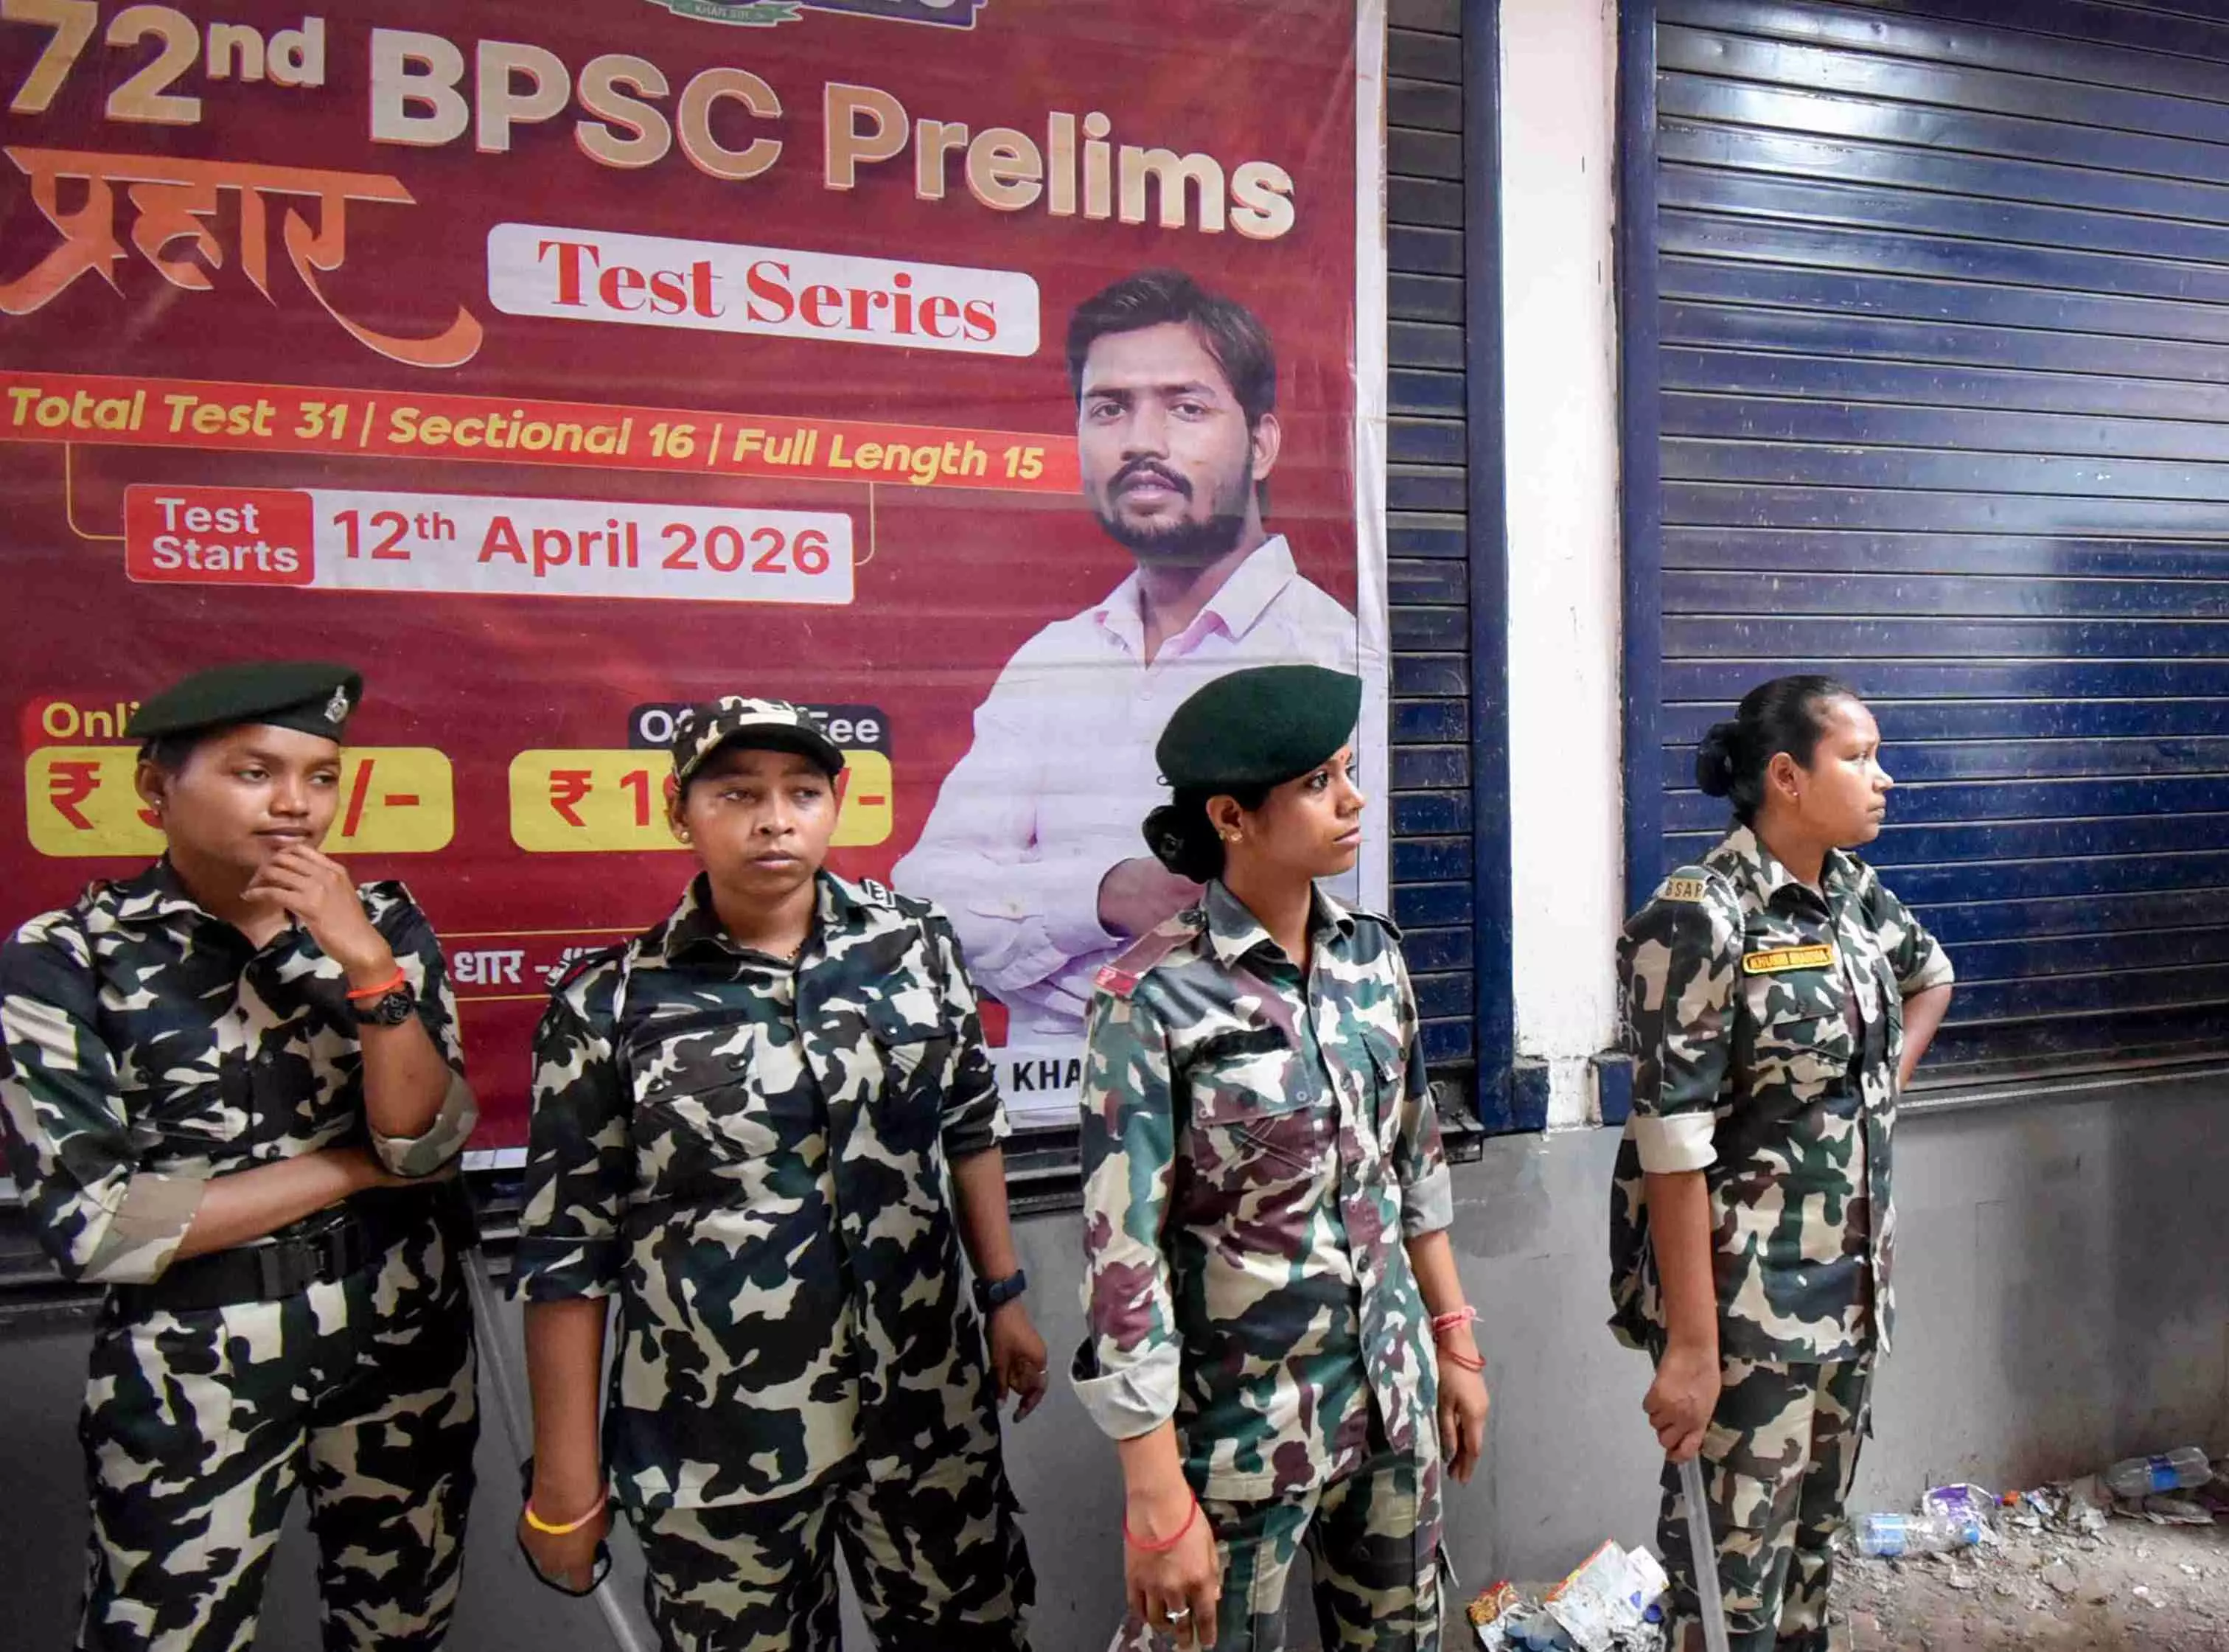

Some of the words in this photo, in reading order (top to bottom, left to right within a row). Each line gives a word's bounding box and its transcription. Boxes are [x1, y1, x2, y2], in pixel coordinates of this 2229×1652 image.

[1, 0, 325, 124] 72nd
[369, 28, 783, 180] BPSC
[823, 82, 1295, 240] Prelims
[0, 147, 483, 367] प्रहार
[539, 241, 725, 318] Test
[747, 261, 997, 342] Series
[8, 388, 146, 431] Total
[164, 395, 276, 437] Test
[296, 402, 347, 440] 31
[388, 408, 632, 455] Sectional
[649, 424, 695, 459] 16
[734, 429, 818, 466] Full
[829, 436, 988, 484] Length
[1003, 447, 1044, 478] 15
[153, 534, 299, 572] Starts
[155, 498, 259, 534] Test
[332, 510, 455, 560] 12th
[477, 516, 638, 577] April
[660, 523, 831, 574] 2026
[1012, 1059, 1081, 1092] KHA
